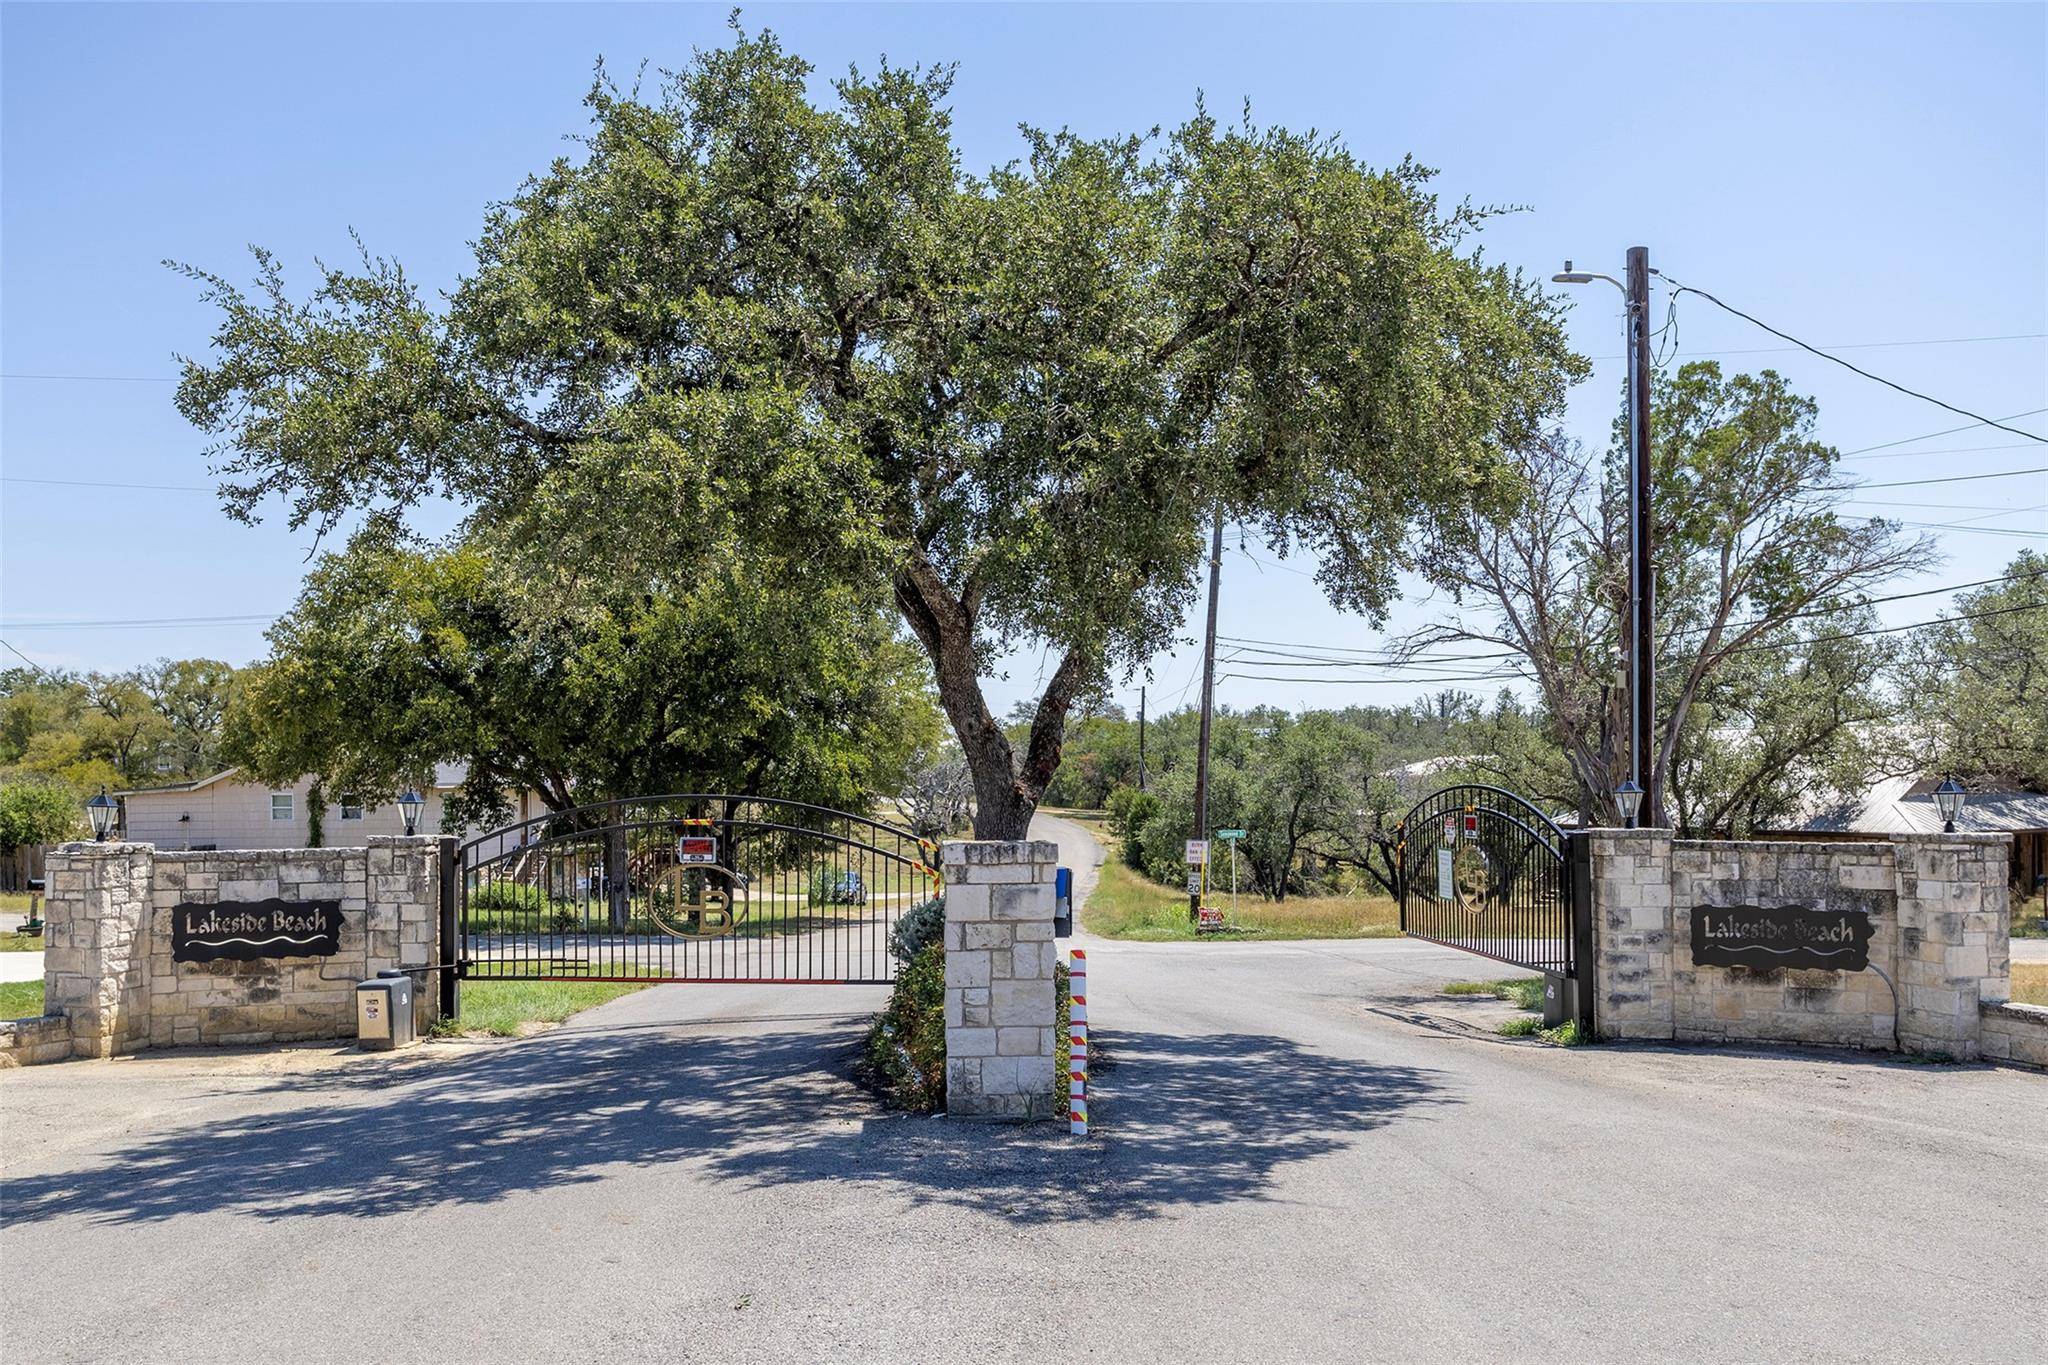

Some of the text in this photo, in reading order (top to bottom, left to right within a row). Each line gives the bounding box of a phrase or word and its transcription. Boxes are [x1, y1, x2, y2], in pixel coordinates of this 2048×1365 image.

[1188, 884, 1200, 893] 20
[184, 908, 328, 934] Lakeside Beach
[1703, 914, 1854, 942] Lakeside Beach
